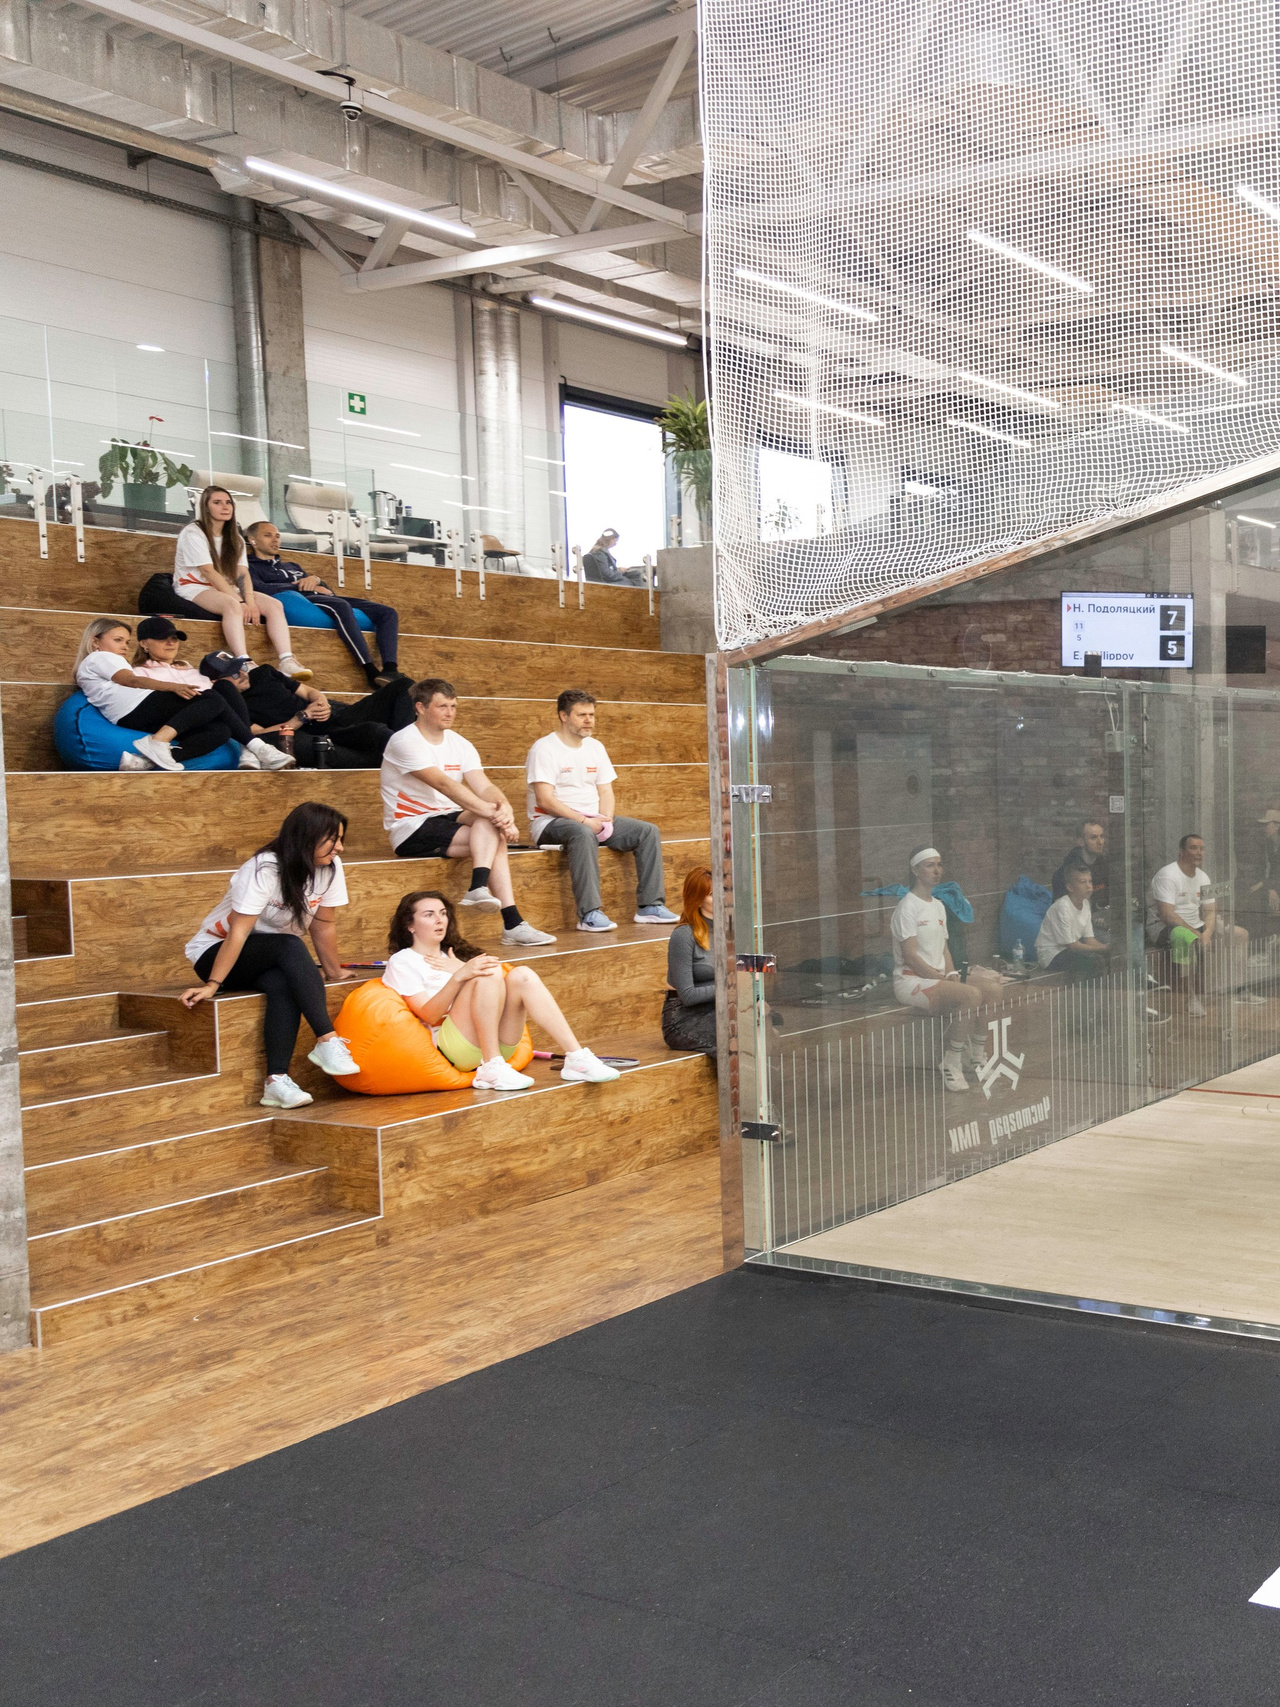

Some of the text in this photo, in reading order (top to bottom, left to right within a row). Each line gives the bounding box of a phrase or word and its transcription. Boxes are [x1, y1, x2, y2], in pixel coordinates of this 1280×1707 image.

[1073, 603, 1155, 614] Н. Подоляцкий
[1167, 611, 1178, 625] 7
[1074, 622, 1084, 630] 11
[1167, 641, 1178, 655] 5
